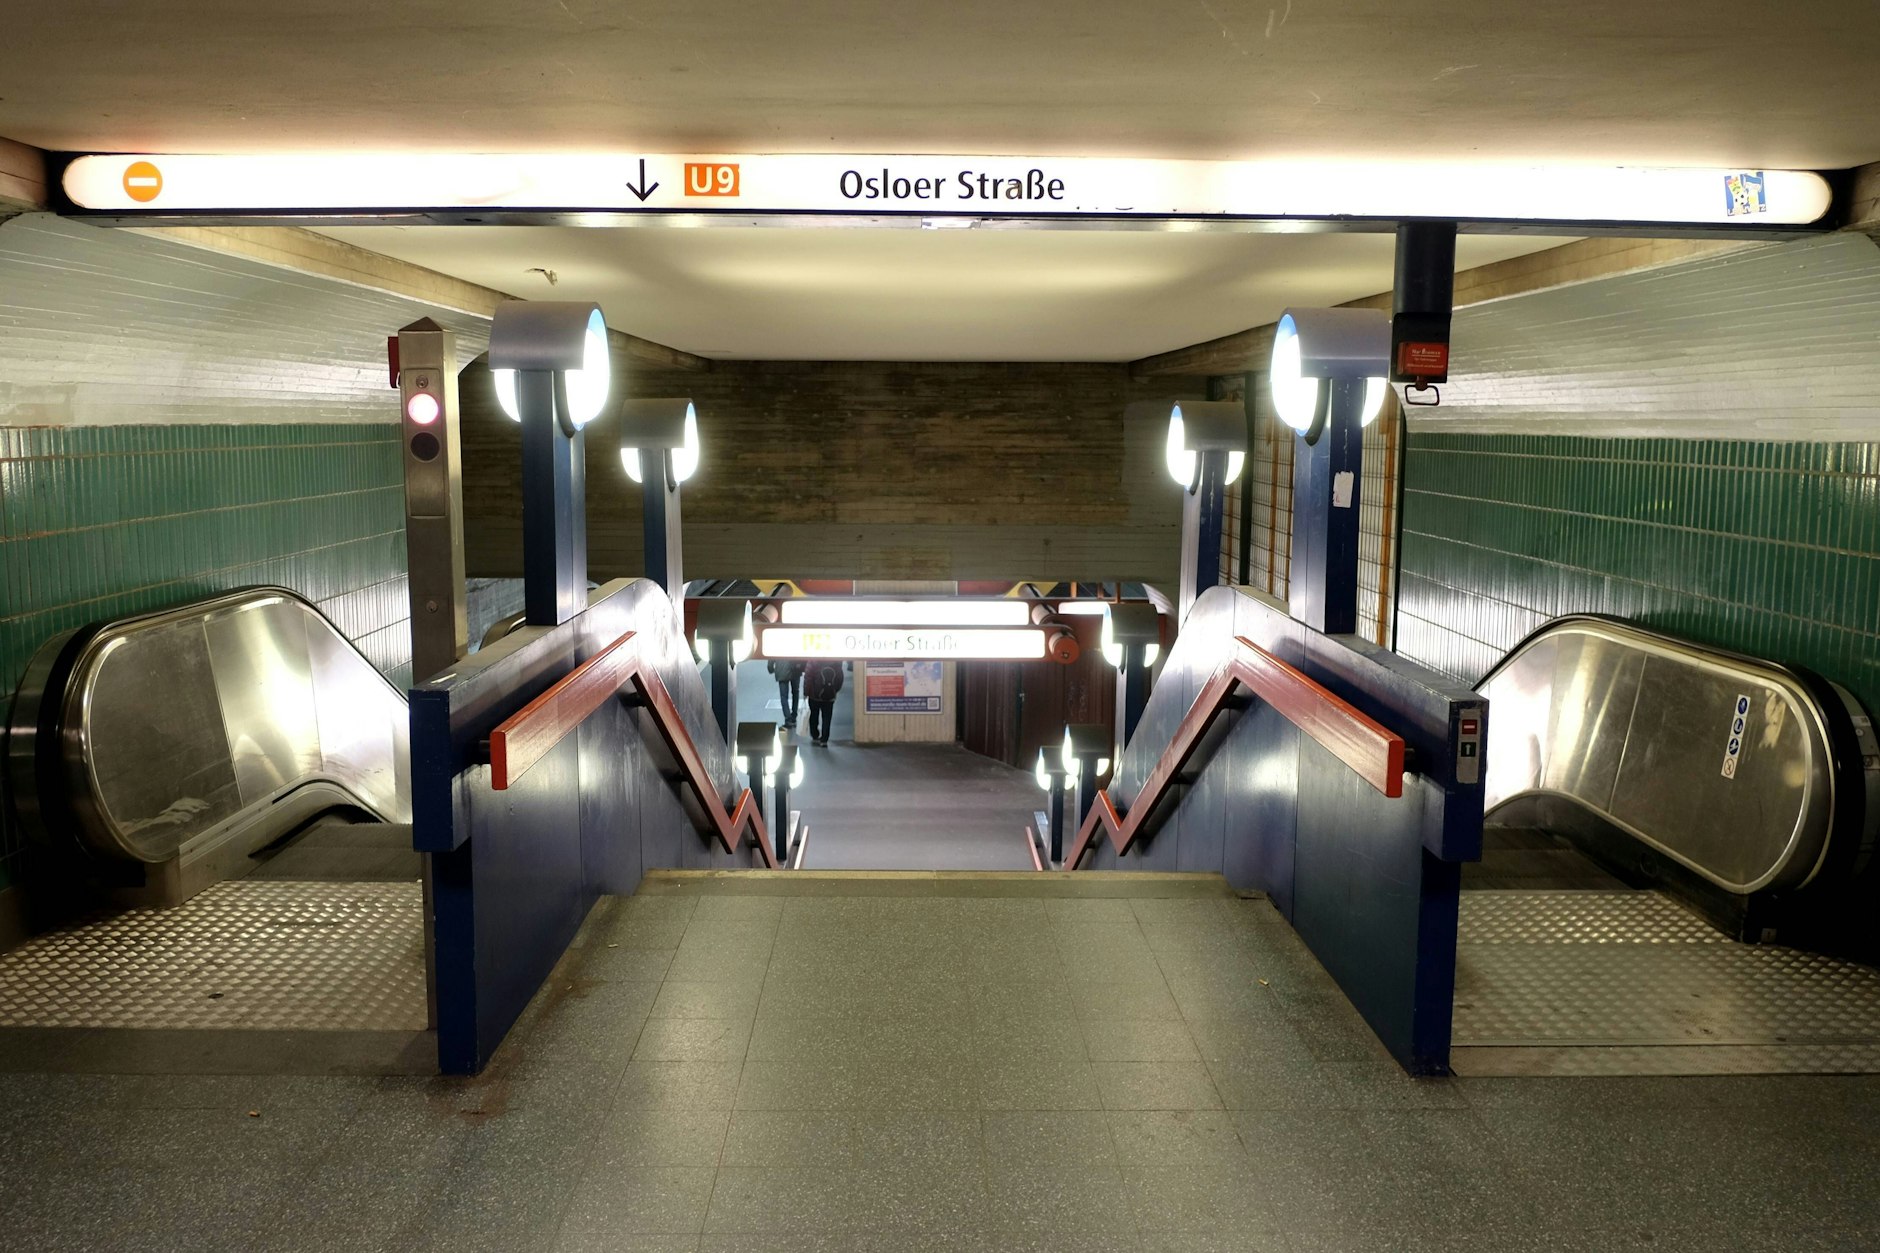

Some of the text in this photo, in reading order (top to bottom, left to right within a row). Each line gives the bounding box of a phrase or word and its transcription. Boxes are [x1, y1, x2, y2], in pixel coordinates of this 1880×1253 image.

[691, 166, 1065, 201] U9 Osloer Straße
[845, 634, 900, 650] Osloer
